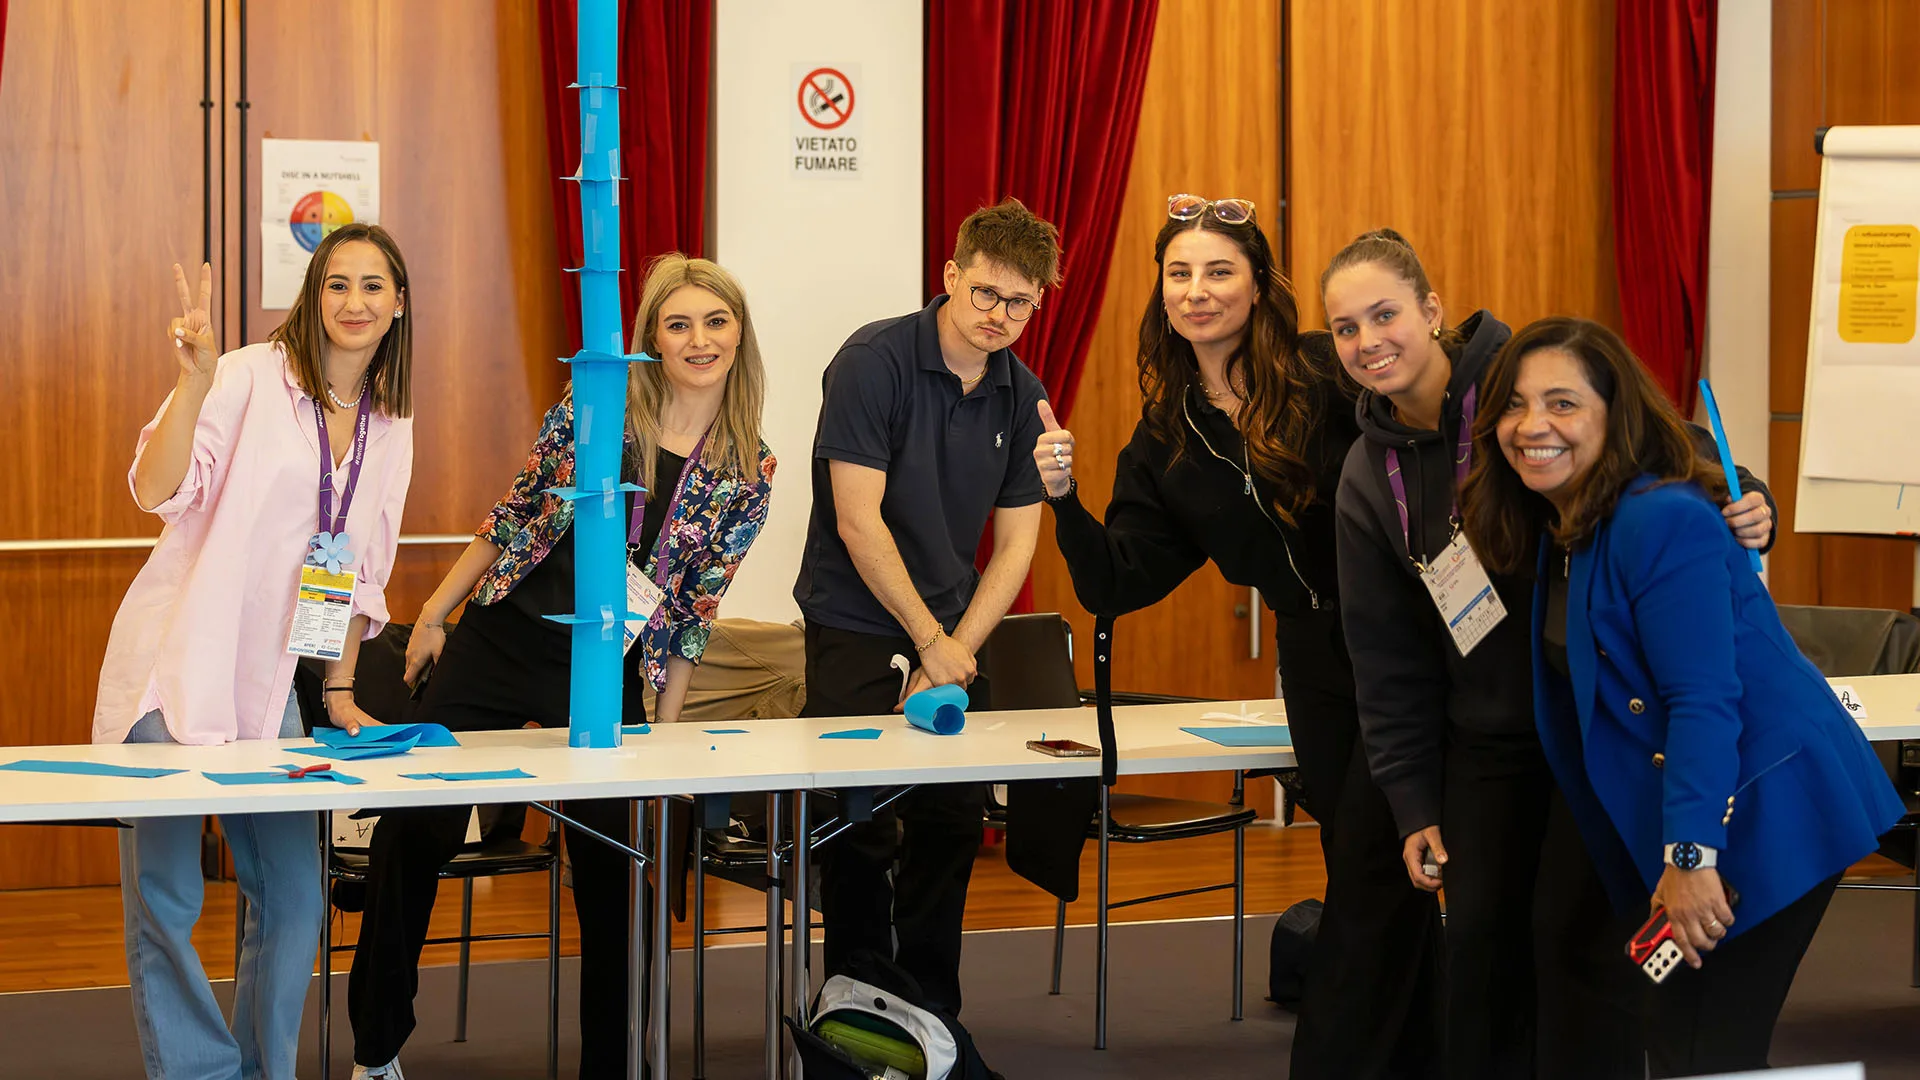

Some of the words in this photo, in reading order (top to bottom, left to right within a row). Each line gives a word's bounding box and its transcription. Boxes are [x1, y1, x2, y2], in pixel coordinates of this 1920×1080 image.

[795, 136, 857, 151] VIETATO
[795, 156, 858, 171] FUMARE
[315, 400, 324, 428] Together
[355, 414, 366, 465] #BetterTogether
